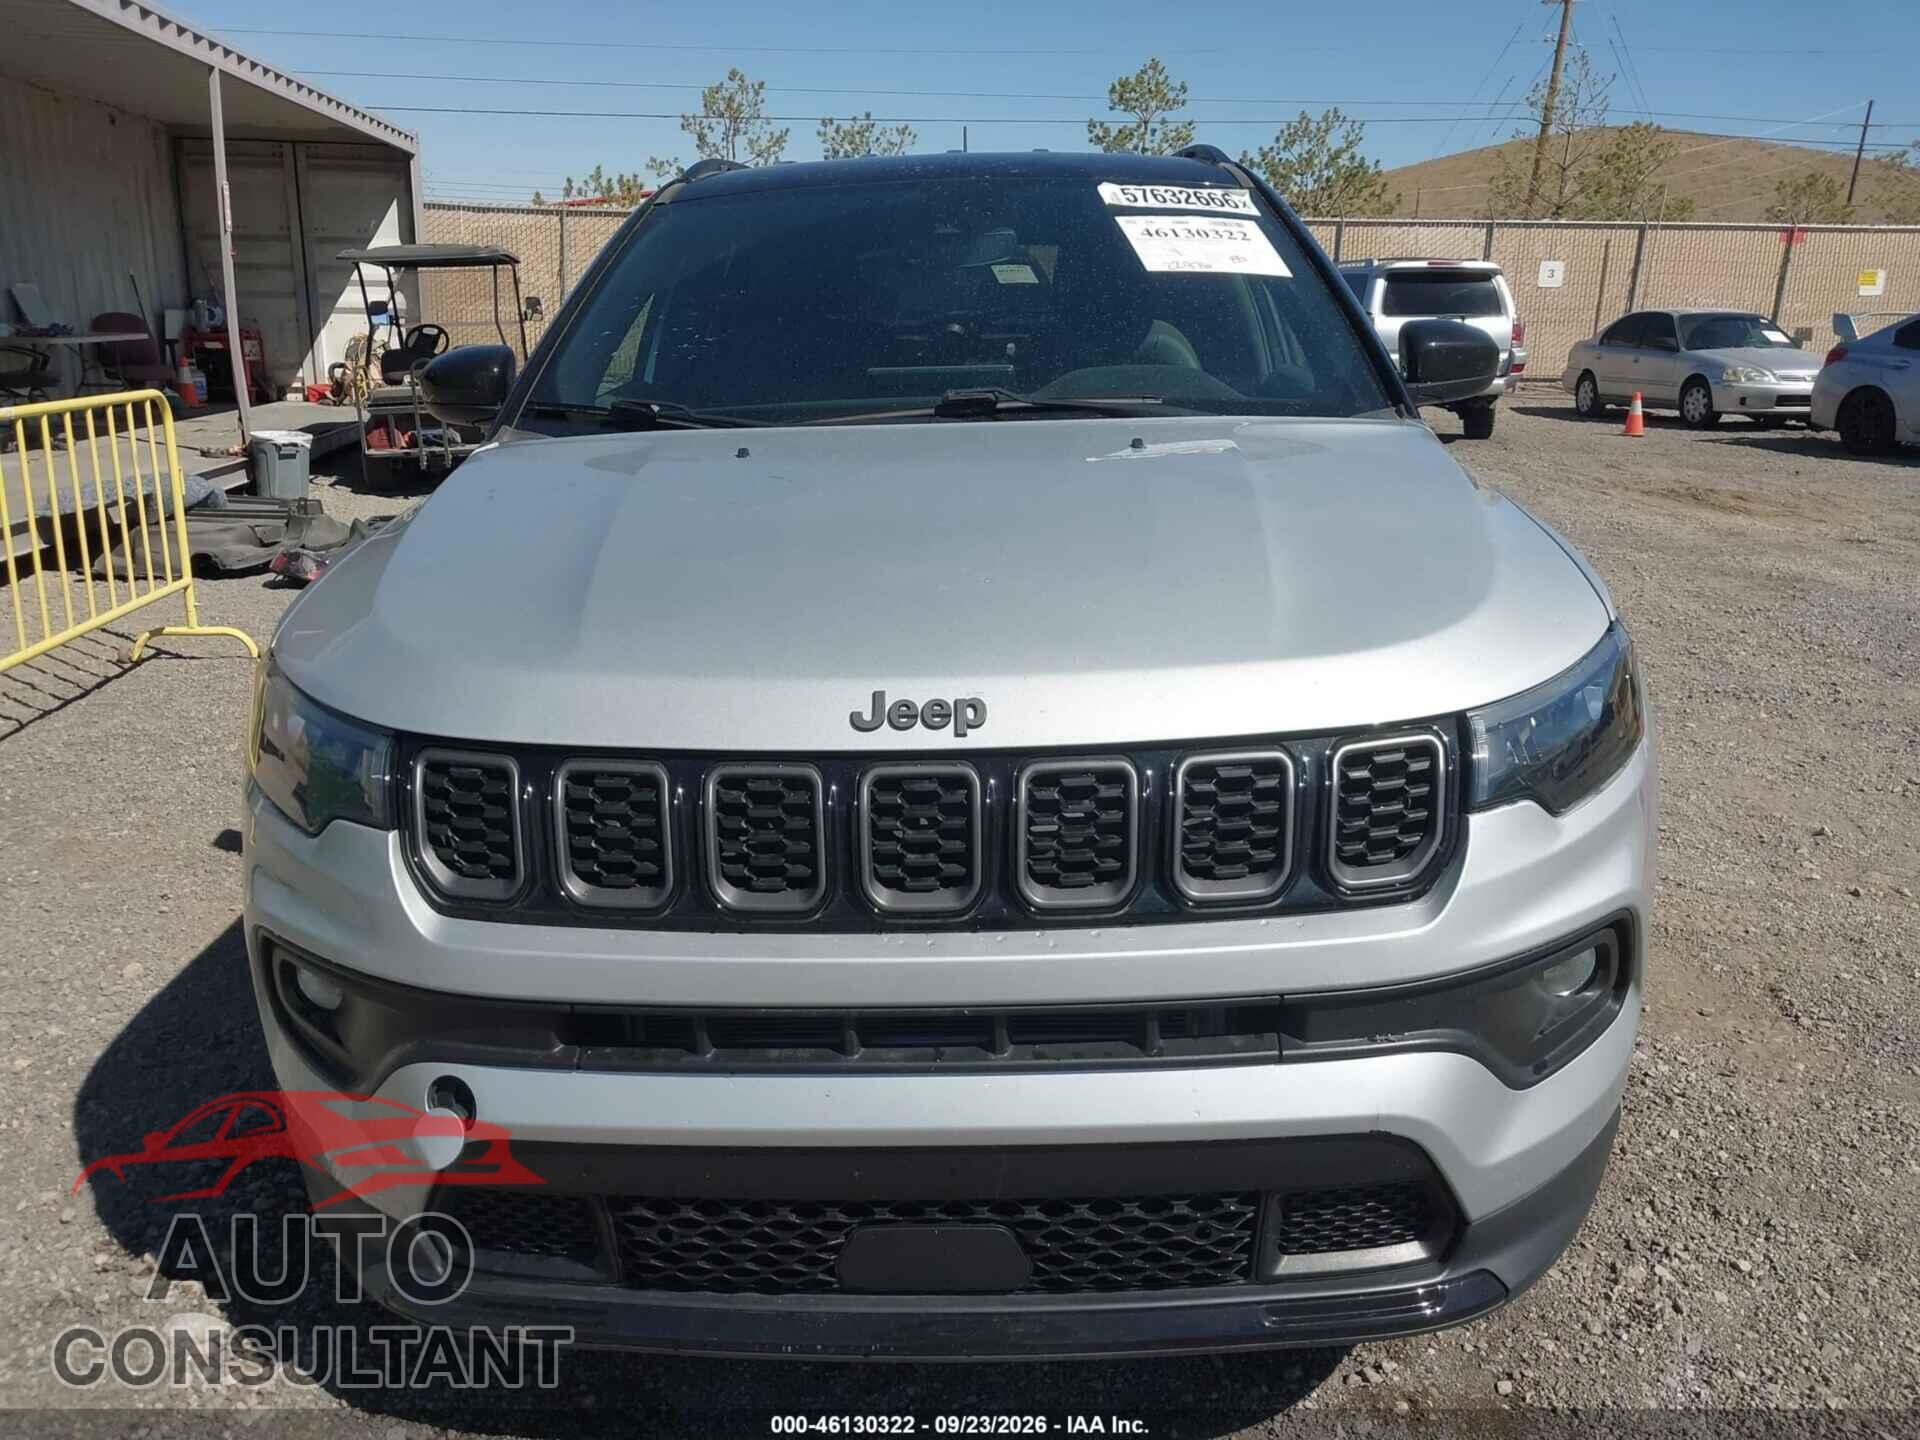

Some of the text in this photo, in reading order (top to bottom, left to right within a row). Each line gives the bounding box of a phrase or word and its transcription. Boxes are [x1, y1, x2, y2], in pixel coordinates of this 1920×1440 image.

[1120, 187, 1239, 209] 57632666
[1140, 227, 1251, 241] 46130322
[849, 690, 987, 738] Jeep
